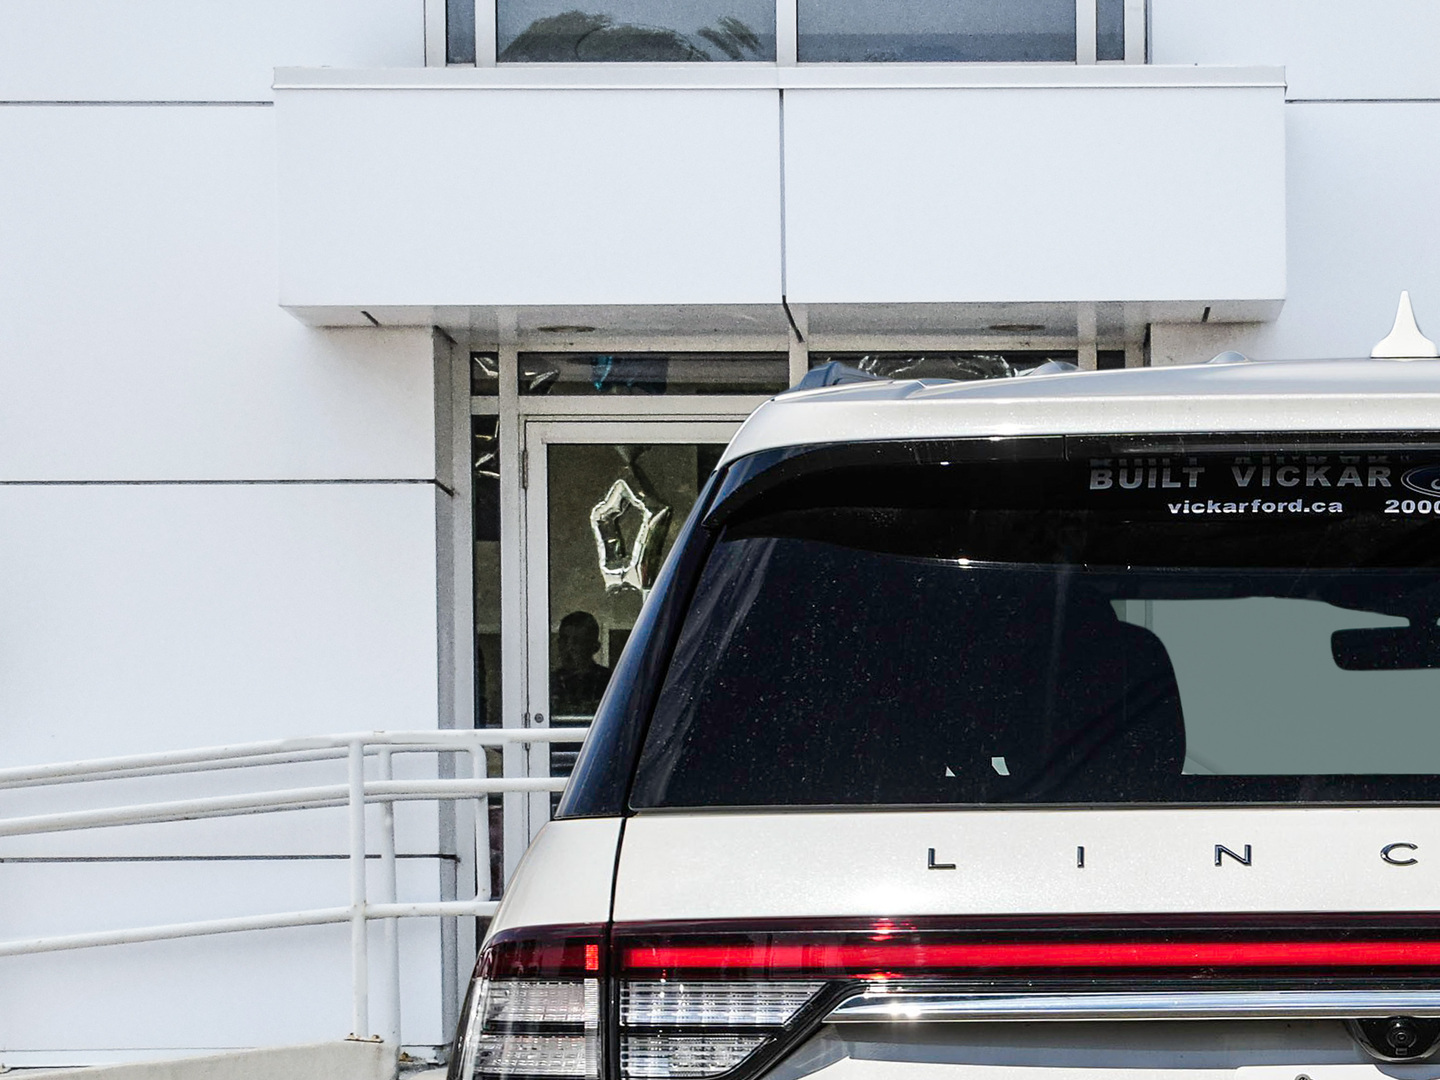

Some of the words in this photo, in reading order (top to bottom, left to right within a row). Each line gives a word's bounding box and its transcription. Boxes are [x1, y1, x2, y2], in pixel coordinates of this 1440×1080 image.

[1089, 466, 1205, 490] BUILT
[1231, 465, 1393, 488] VICKAR
[1167, 499, 1343, 515] vickarford.ca
